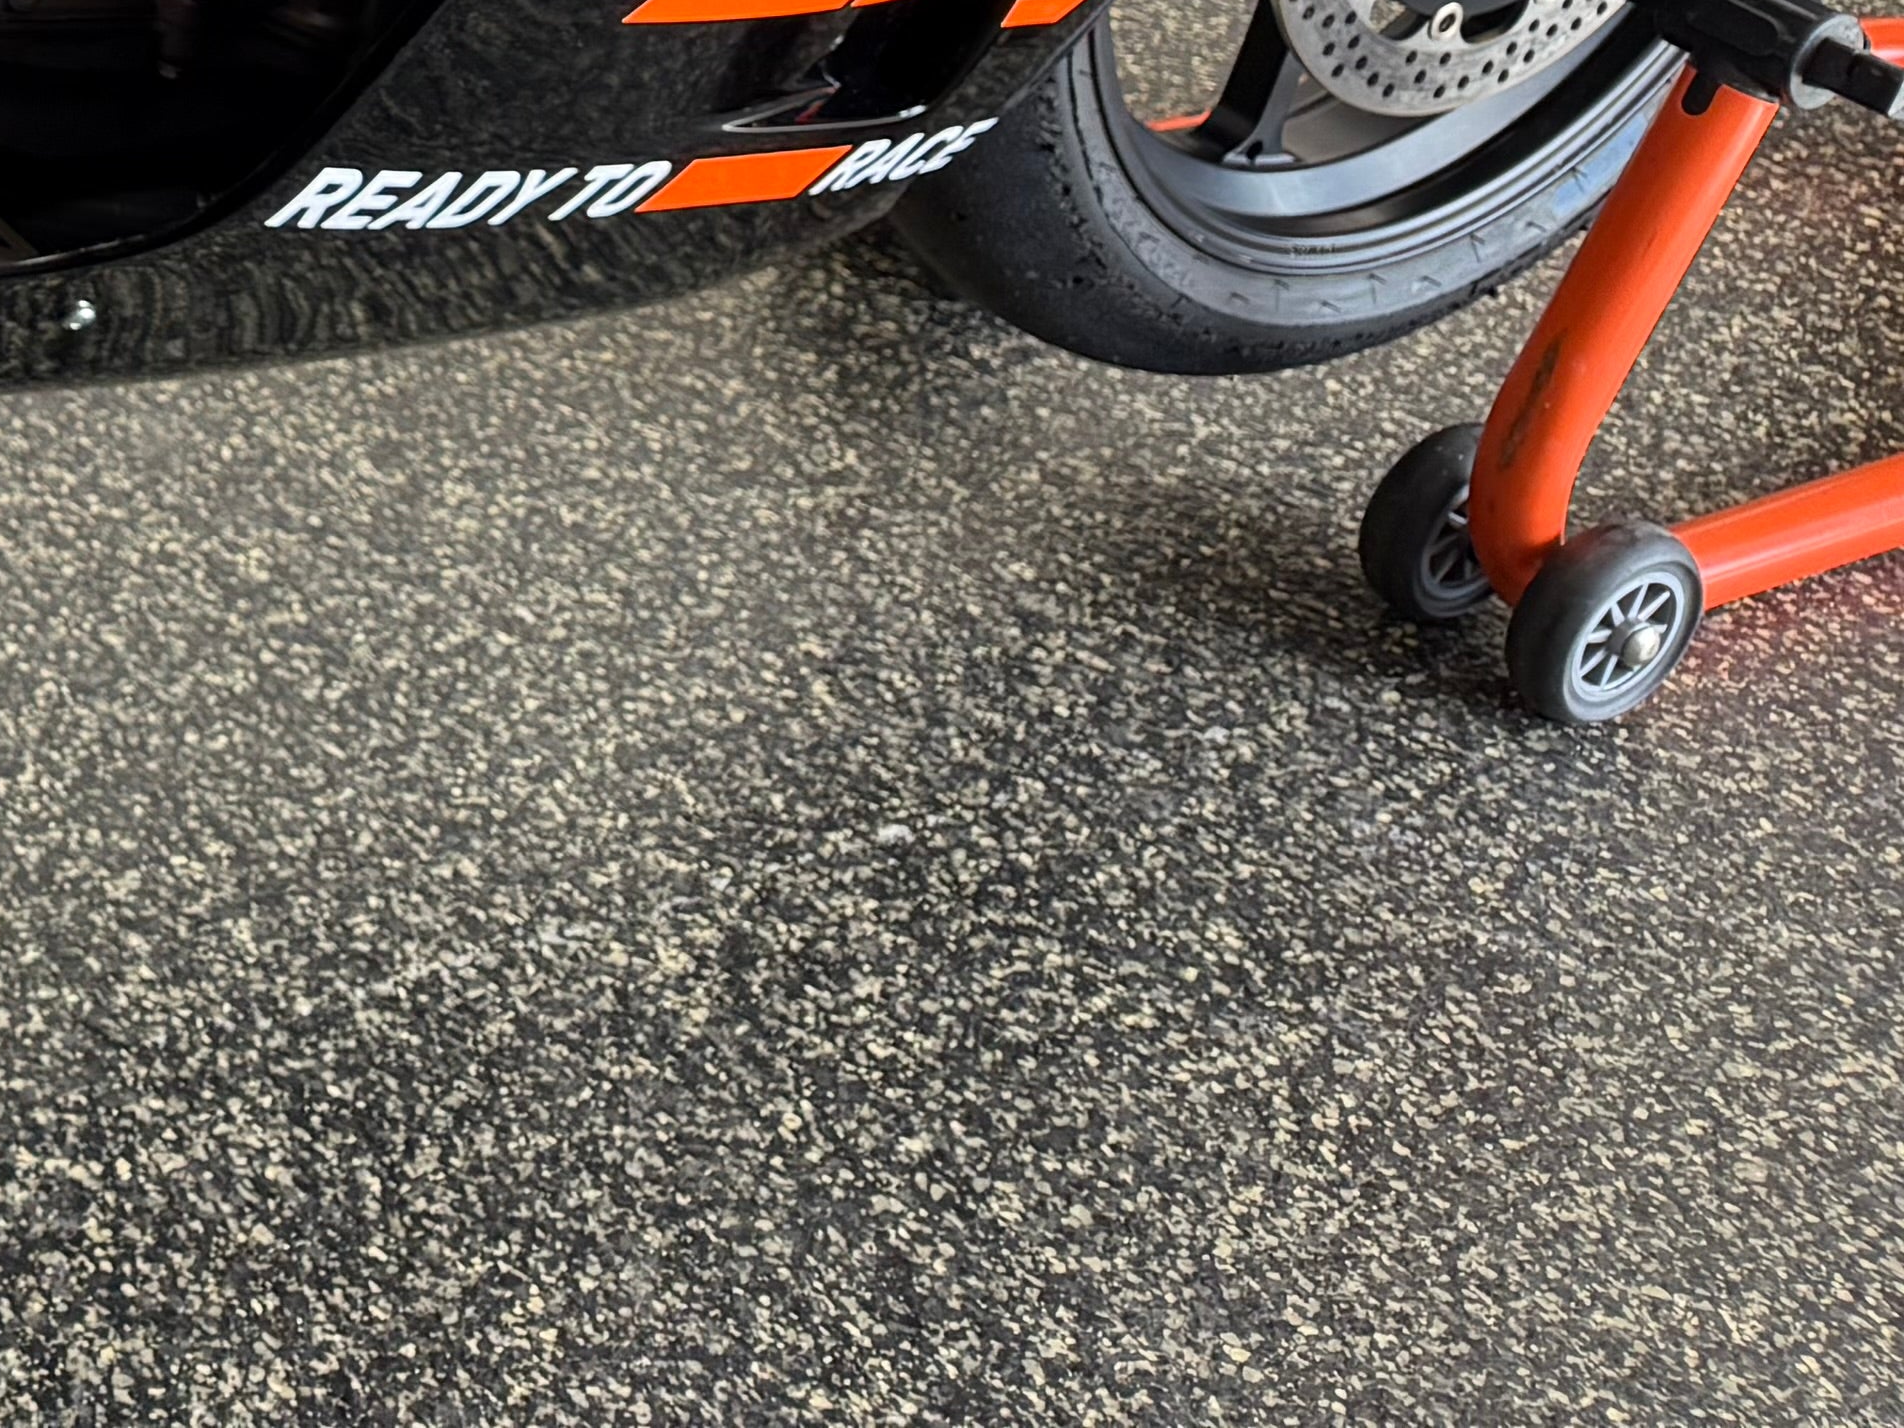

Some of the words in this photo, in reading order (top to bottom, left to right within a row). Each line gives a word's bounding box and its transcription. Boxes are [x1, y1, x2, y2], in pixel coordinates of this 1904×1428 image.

[263, 165, 579, 231] READY
[547, 160, 673, 222] TO
[808, 117, 1000, 197] RACE
